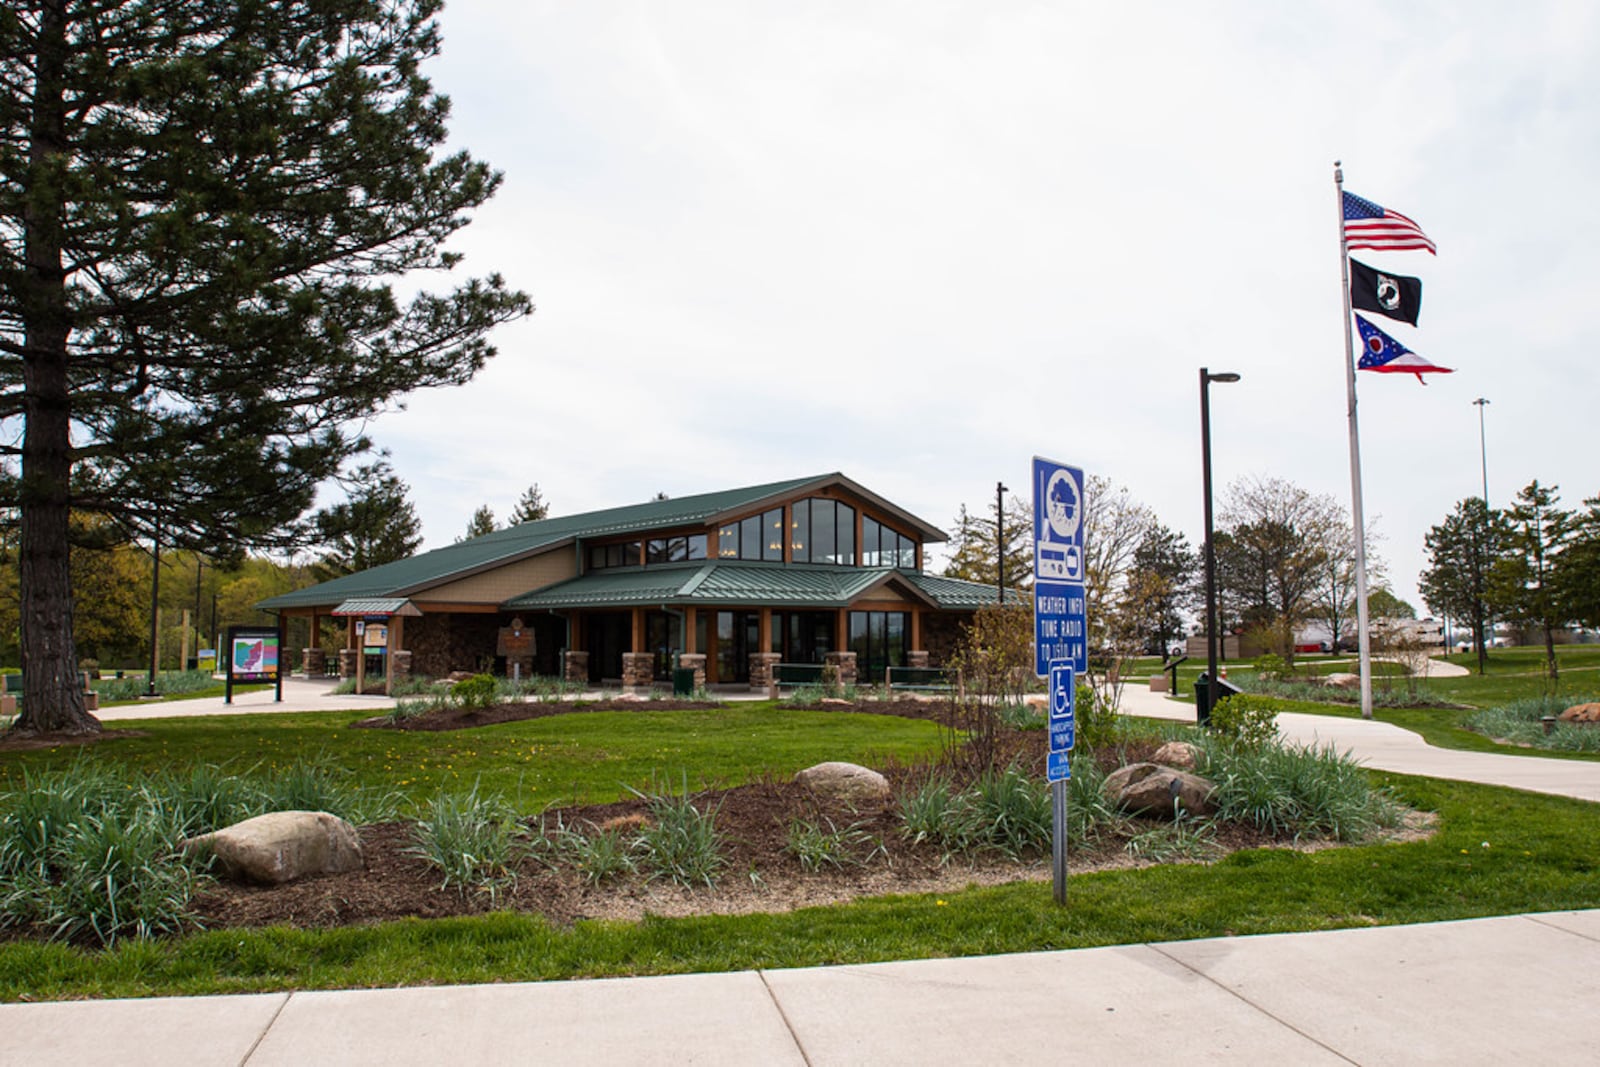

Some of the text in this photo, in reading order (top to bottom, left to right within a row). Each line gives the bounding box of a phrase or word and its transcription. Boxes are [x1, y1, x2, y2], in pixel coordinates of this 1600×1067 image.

[1038, 596, 1083, 615] WEATHER INFO
[1041, 619, 1082, 638] TUNE RADIO
[1041, 643, 1050, 661] TO
